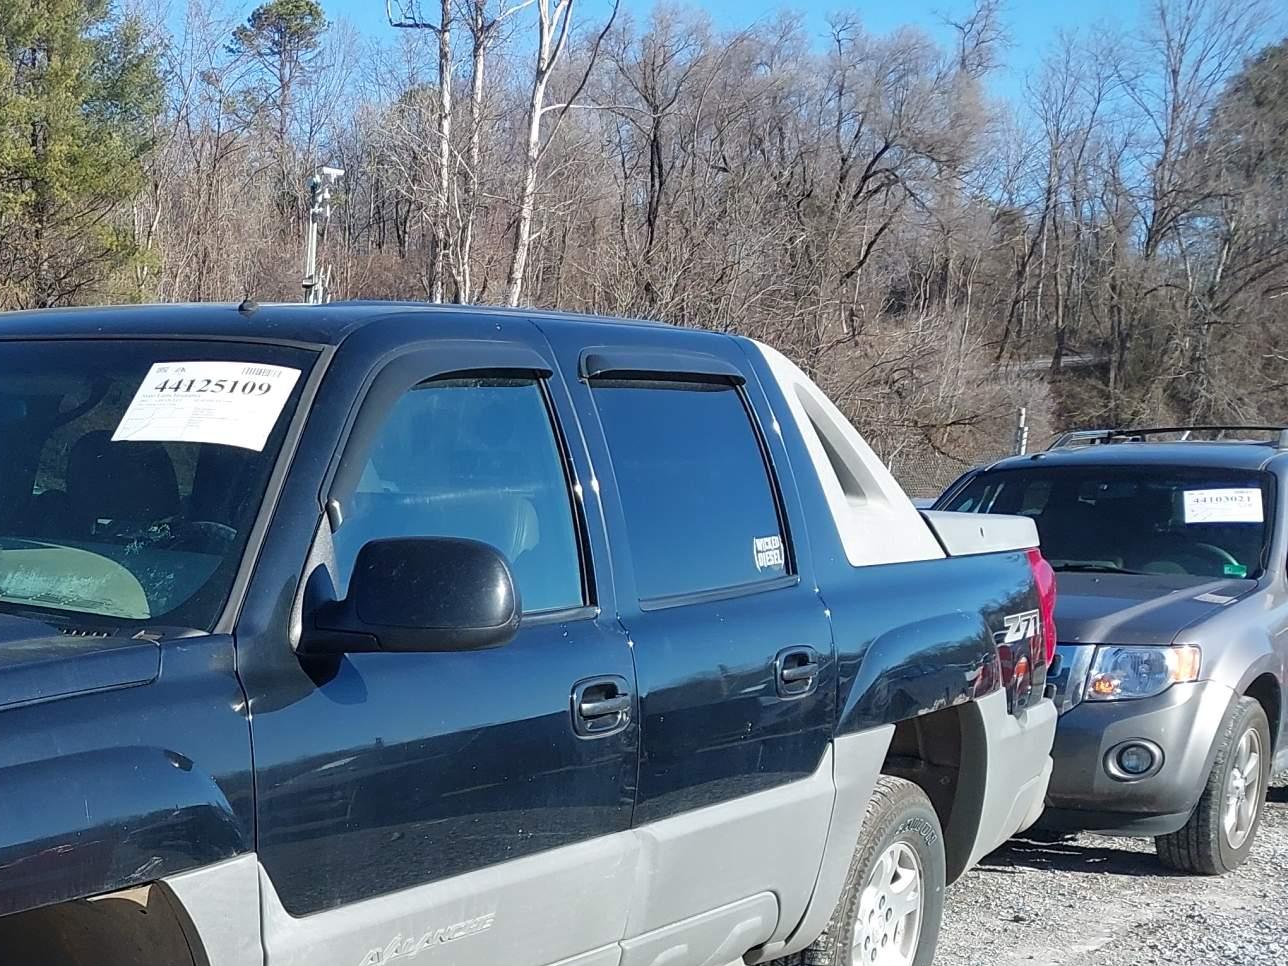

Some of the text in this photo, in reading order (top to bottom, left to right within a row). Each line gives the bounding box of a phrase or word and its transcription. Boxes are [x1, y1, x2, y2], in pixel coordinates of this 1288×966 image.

[154, 378, 272, 396] 44125109
[1193, 495, 1252, 504] 44103021
[757, 550, 782, 567] DIESEL
[1003, 608, 1041, 643] Z71
